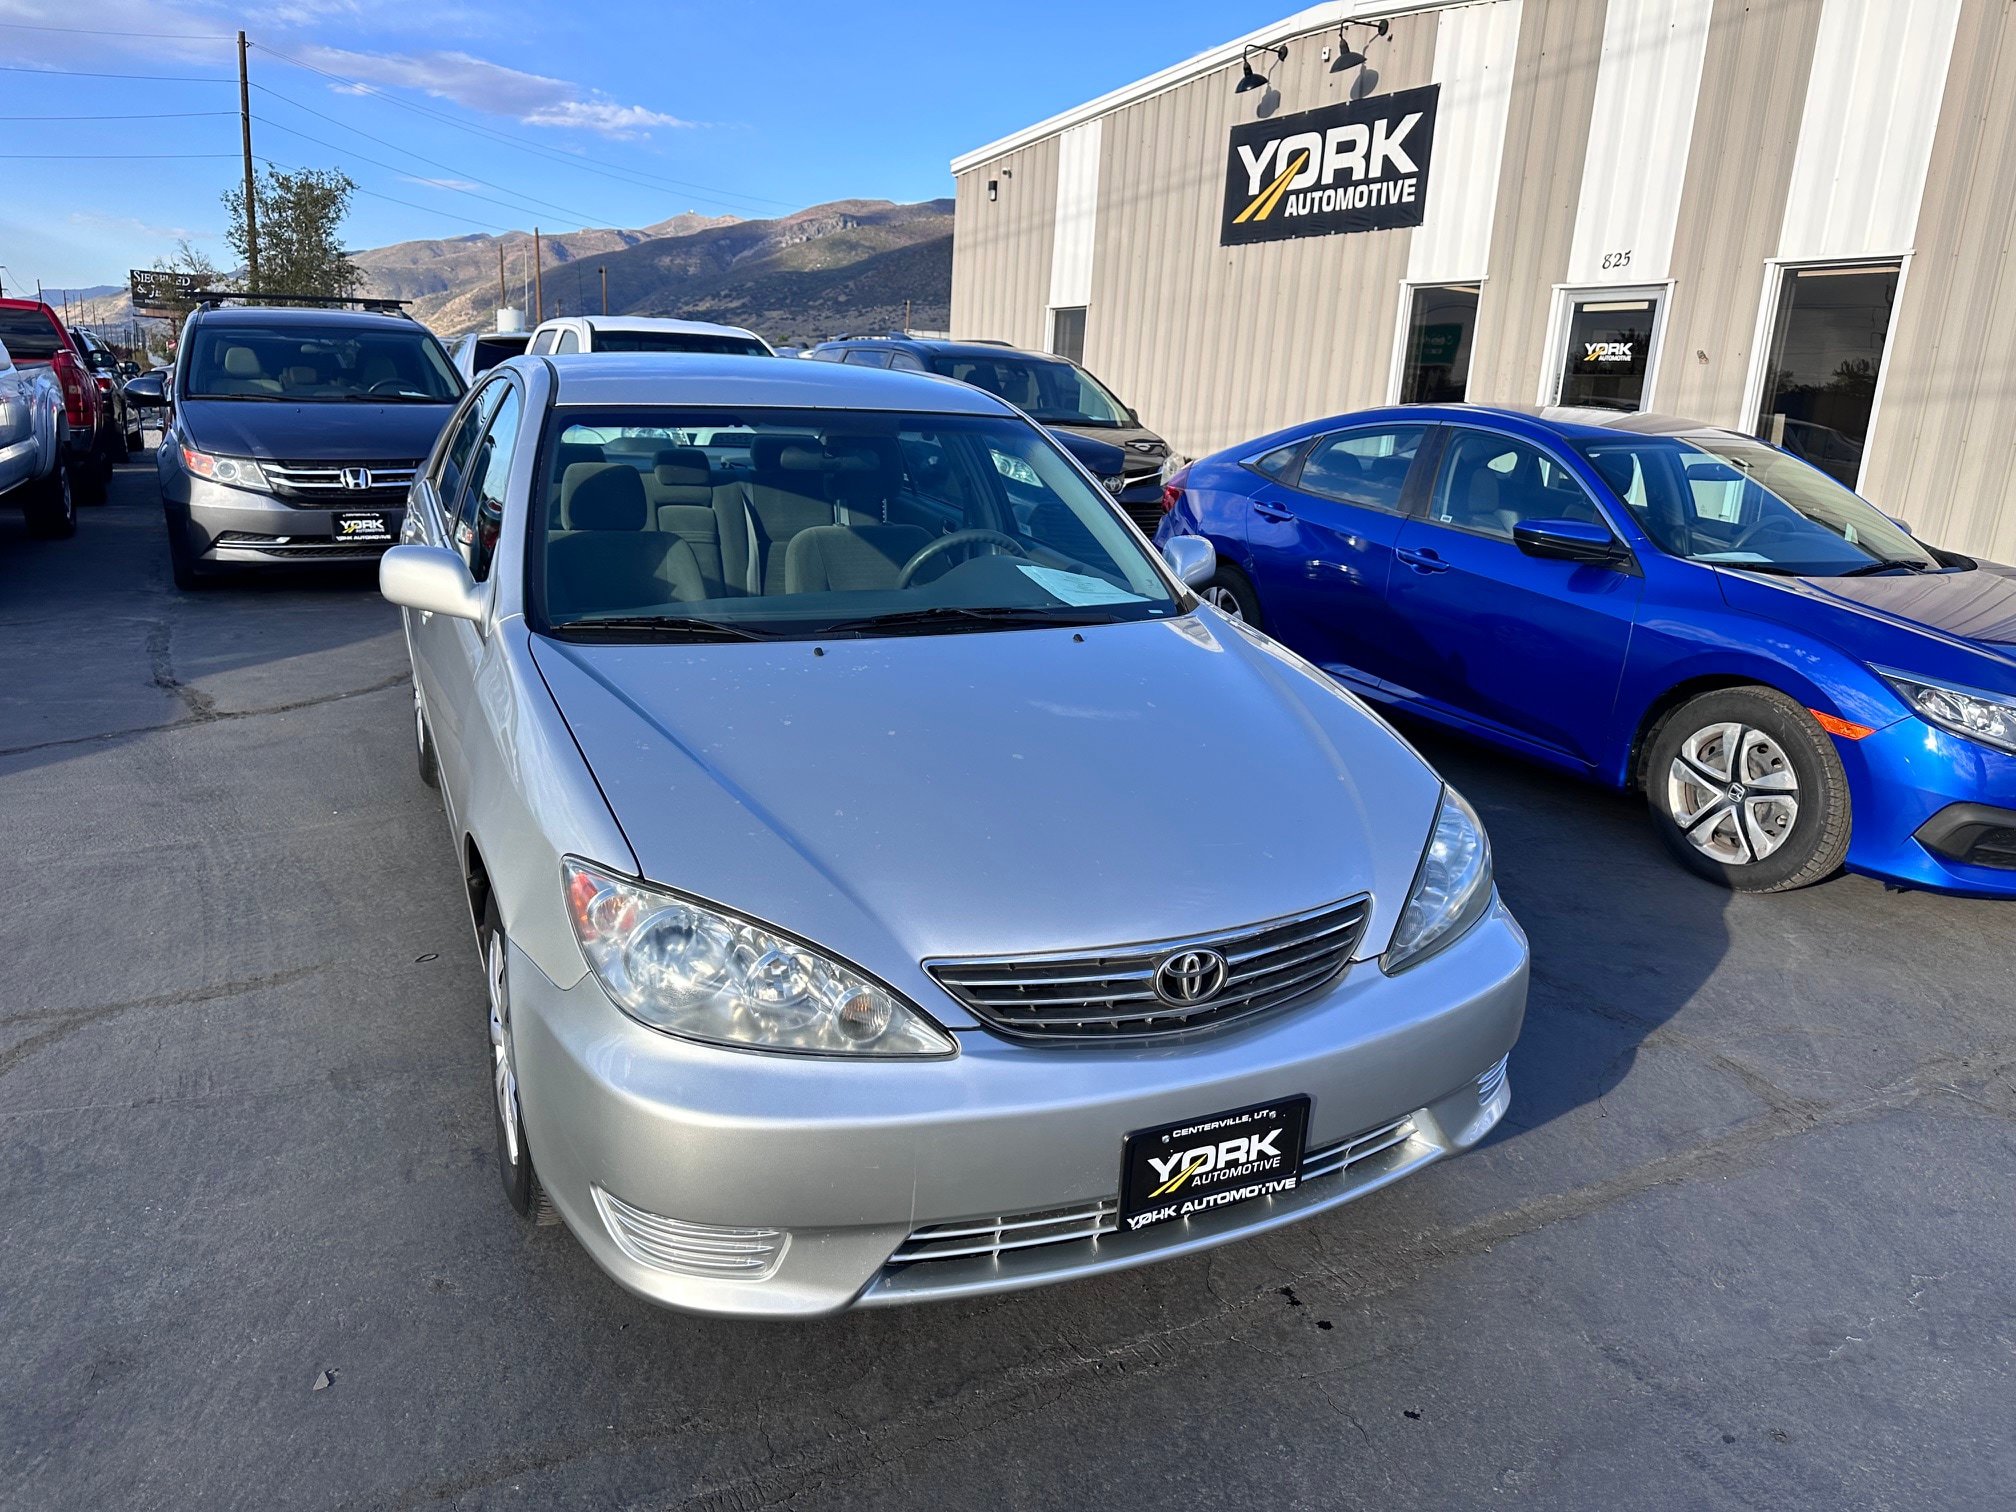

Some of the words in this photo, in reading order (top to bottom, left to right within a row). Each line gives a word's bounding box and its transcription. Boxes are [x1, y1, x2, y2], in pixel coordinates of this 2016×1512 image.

[1236, 111, 1424, 196] YORK
[1284, 177, 1417, 218] AUTOMOTIVE
[1602, 250, 1631, 270] 825
[1584, 342, 1633, 355] YORK
[1598, 354, 1632, 362] AUTOMOTIVE
[340, 519, 384, 530] YORK
[1172, 1115, 1252, 1138] CENTERVILLE,
[1254, 1109, 1270, 1120] UT
[1147, 1127, 1283, 1183] YORK
[1191, 1156, 1282, 1188] AUTOMOTIVE
[1180, 1177, 1297, 1214] AUTOMOTIVE
